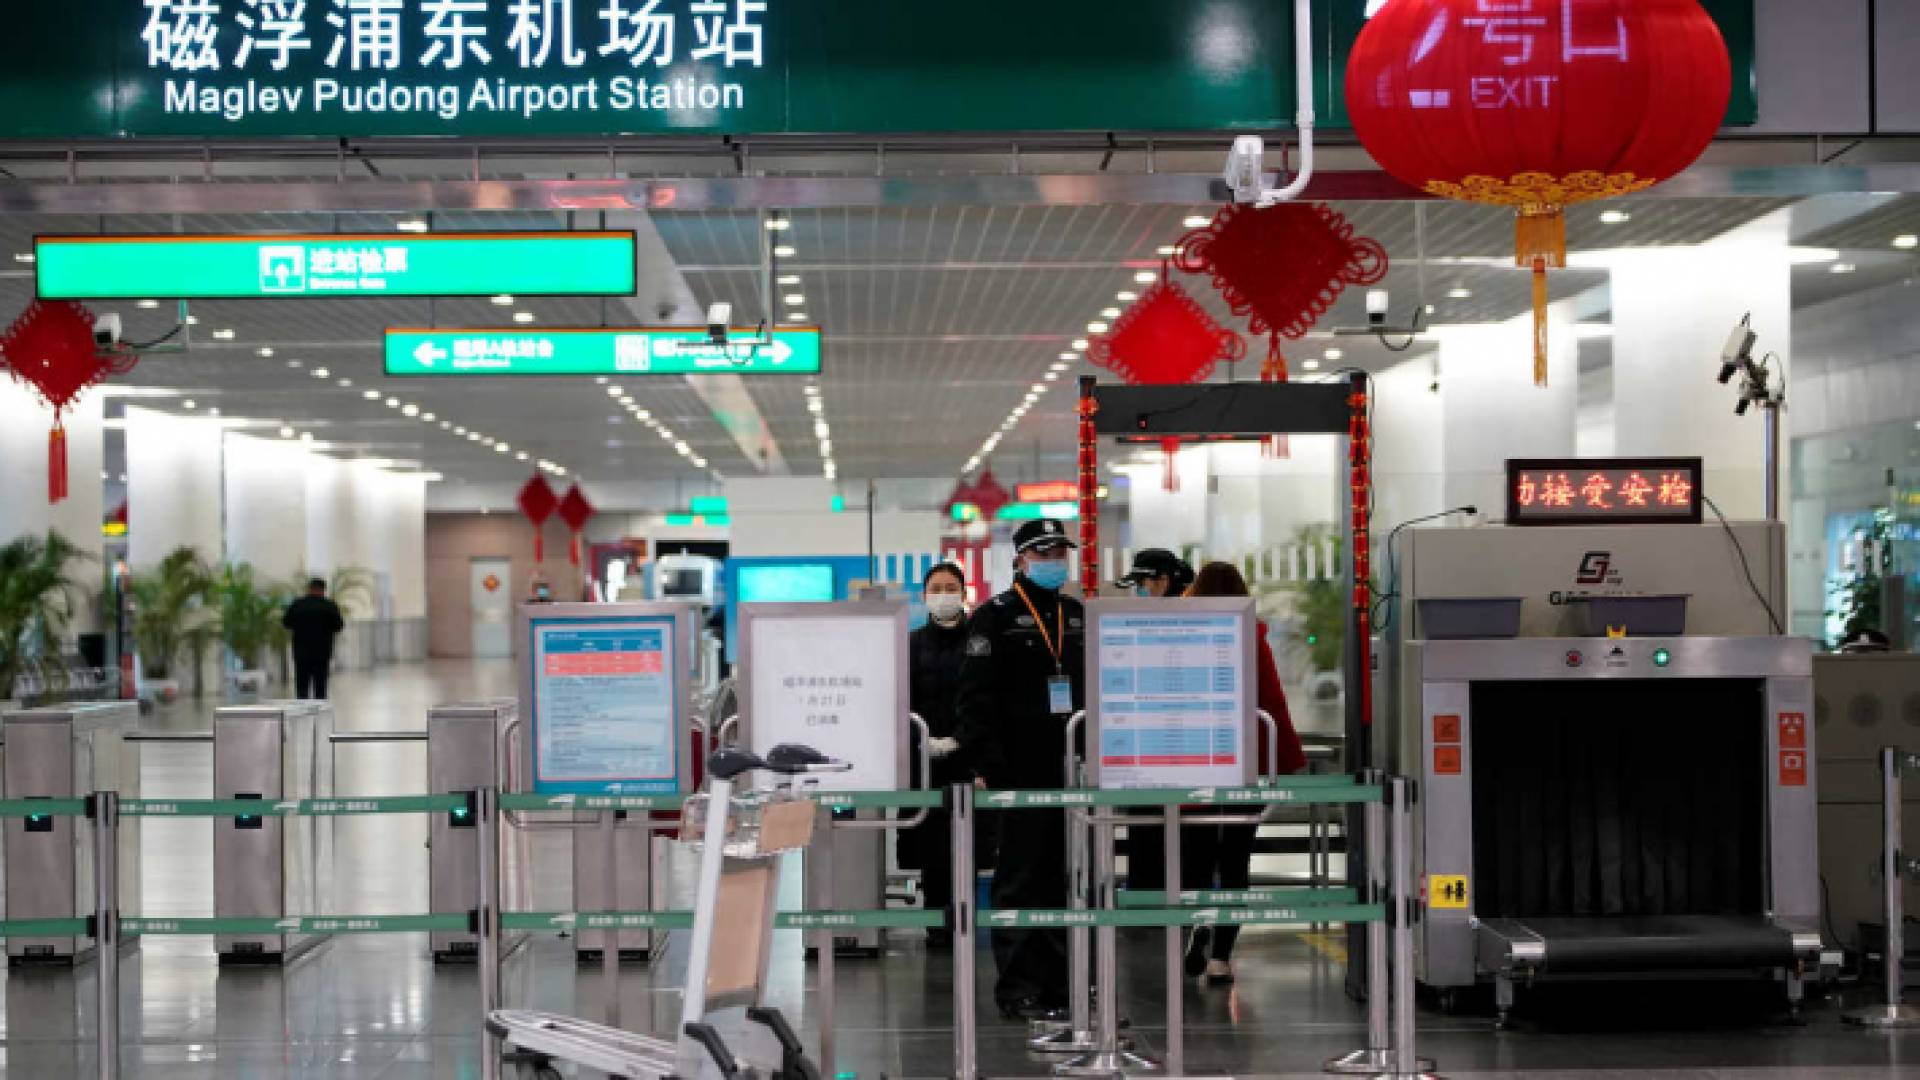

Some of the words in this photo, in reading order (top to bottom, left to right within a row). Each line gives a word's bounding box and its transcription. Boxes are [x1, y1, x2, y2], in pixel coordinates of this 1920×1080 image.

[141, 0, 767, 70] 磁浮浦东机场站
[164, 80, 303, 119] Maglev
[313, 78, 458, 118] Pudong
[467, 76, 599, 117] Airport
[609, 76, 744, 110] Station
[1471, 75, 1558, 108] EXIT
